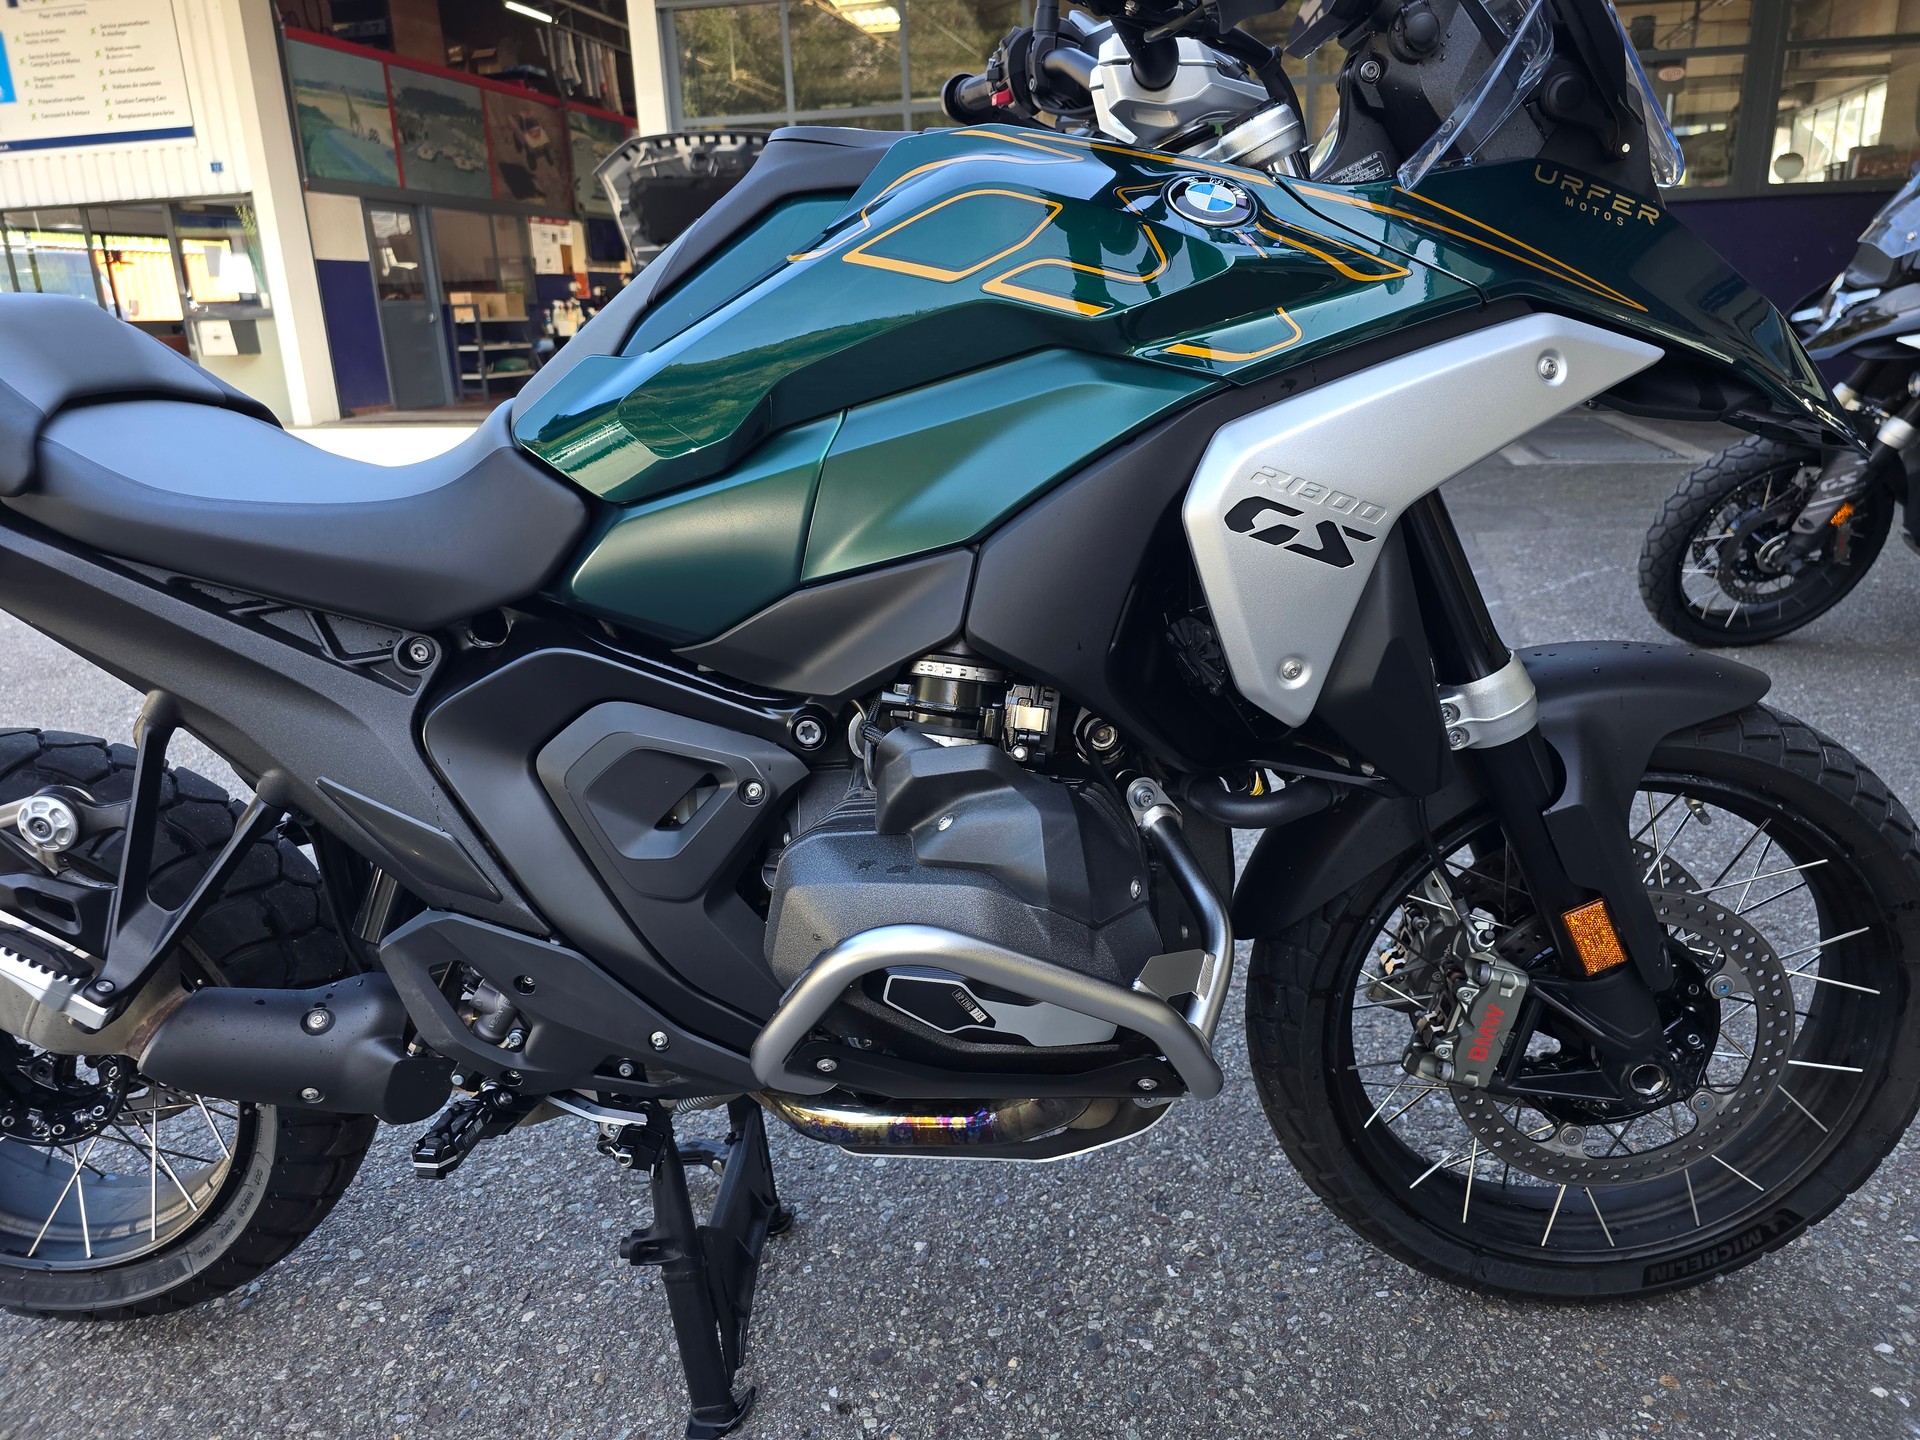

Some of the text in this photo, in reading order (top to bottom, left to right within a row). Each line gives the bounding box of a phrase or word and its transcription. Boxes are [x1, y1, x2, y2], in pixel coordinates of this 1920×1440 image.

[135, 96, 155, 104] Camping
[1534, 164, 1660, 226] URFER
[1565, 196, 1624, 226] MOTOS
[1224, 496, 1377, 568] GS
[972, 1009, 985, 1021] 719
[1468, 1003, 1505, 1062] BMW
[1650, 1229, 1763, 1282] MICHELIN
